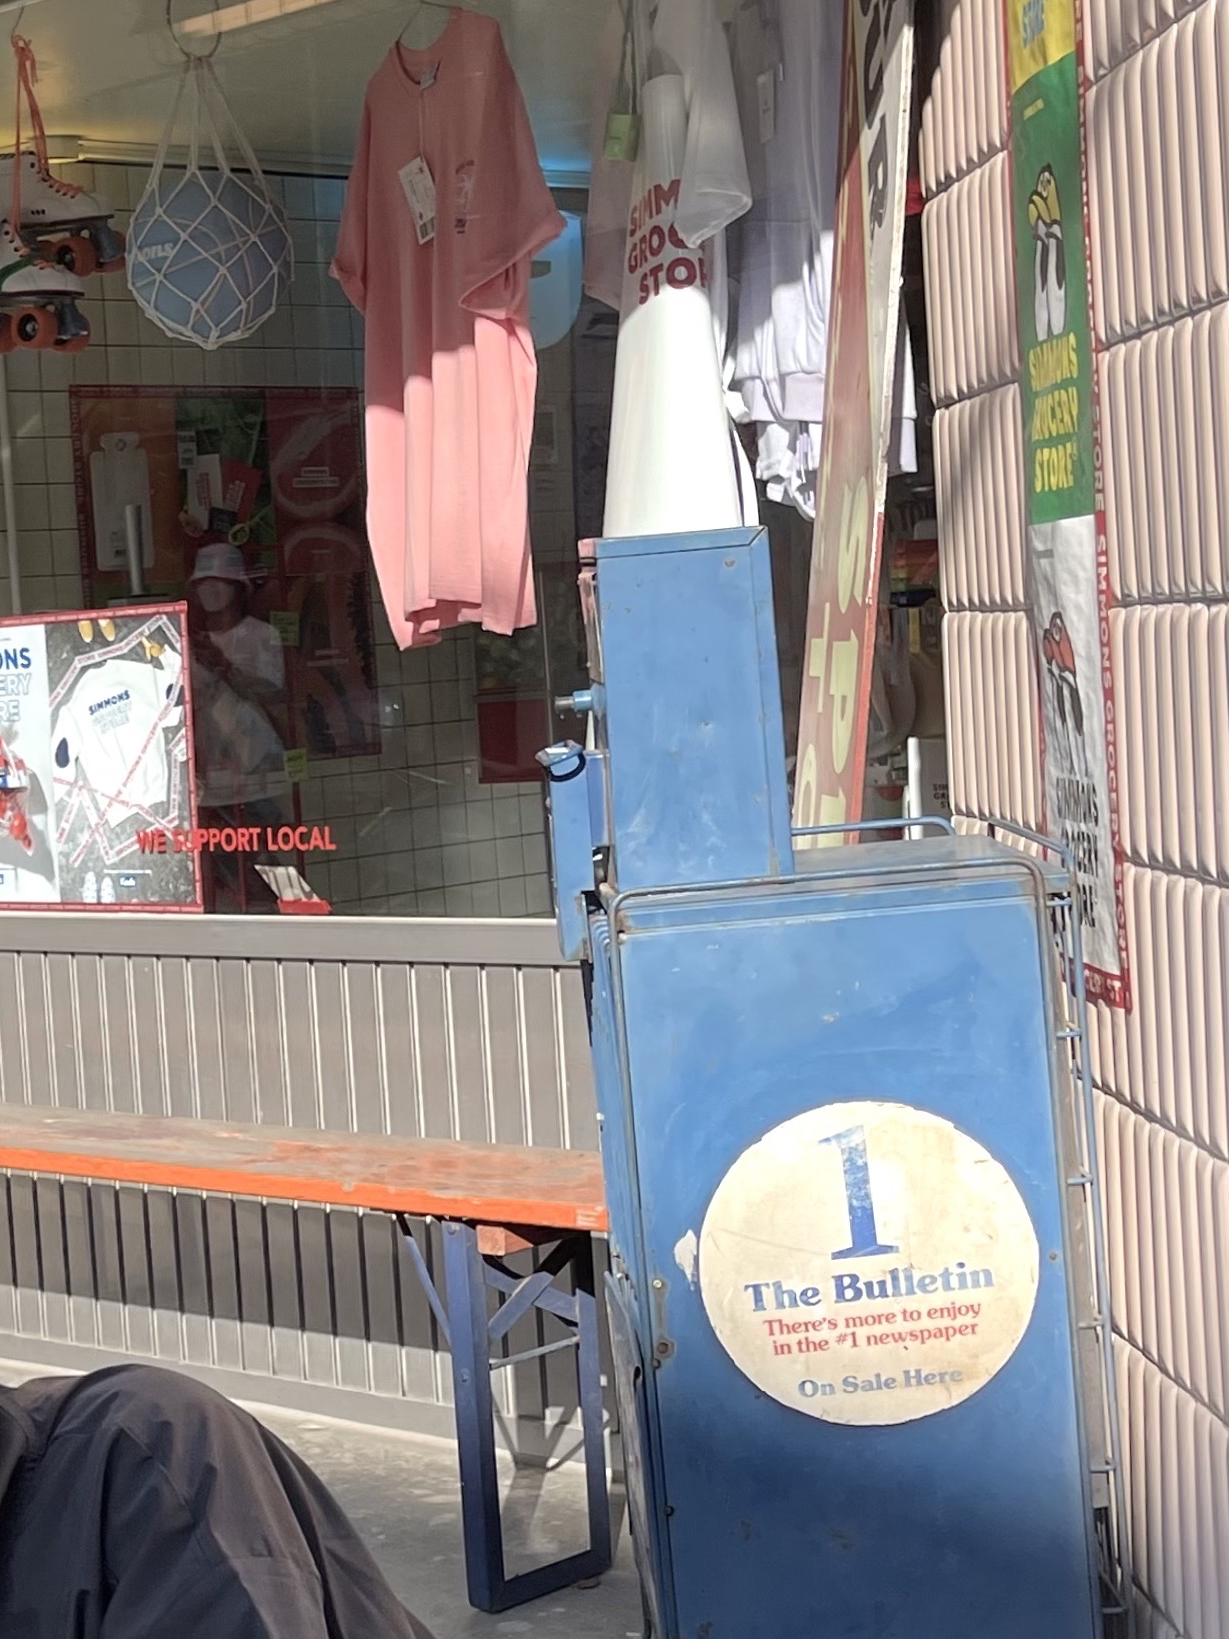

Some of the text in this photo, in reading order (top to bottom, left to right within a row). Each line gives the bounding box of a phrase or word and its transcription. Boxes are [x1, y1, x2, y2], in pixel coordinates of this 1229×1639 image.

[630, 179, 681, 238] SIMM
[1035, 442, 1074, 493] STORE
[1096, 535, 1113, 690] SIMMONS
[88, 689, 131, 716] SIMMONS
[1104, 701, 1120, 849] GROCERY
[137, 829, 167, 854] WE
[267, 826, 337, 851] LOCAL
[817, 1123, 900, 1261] 1
[744, 1261, 995, 1313] The Bulletin
[763, 1301, 983, 1338] There's more to enjoy
[772, 1322, 980, 1356] in the #1 newspaper
[798, 1367, 964, 1399] On Sale Here
